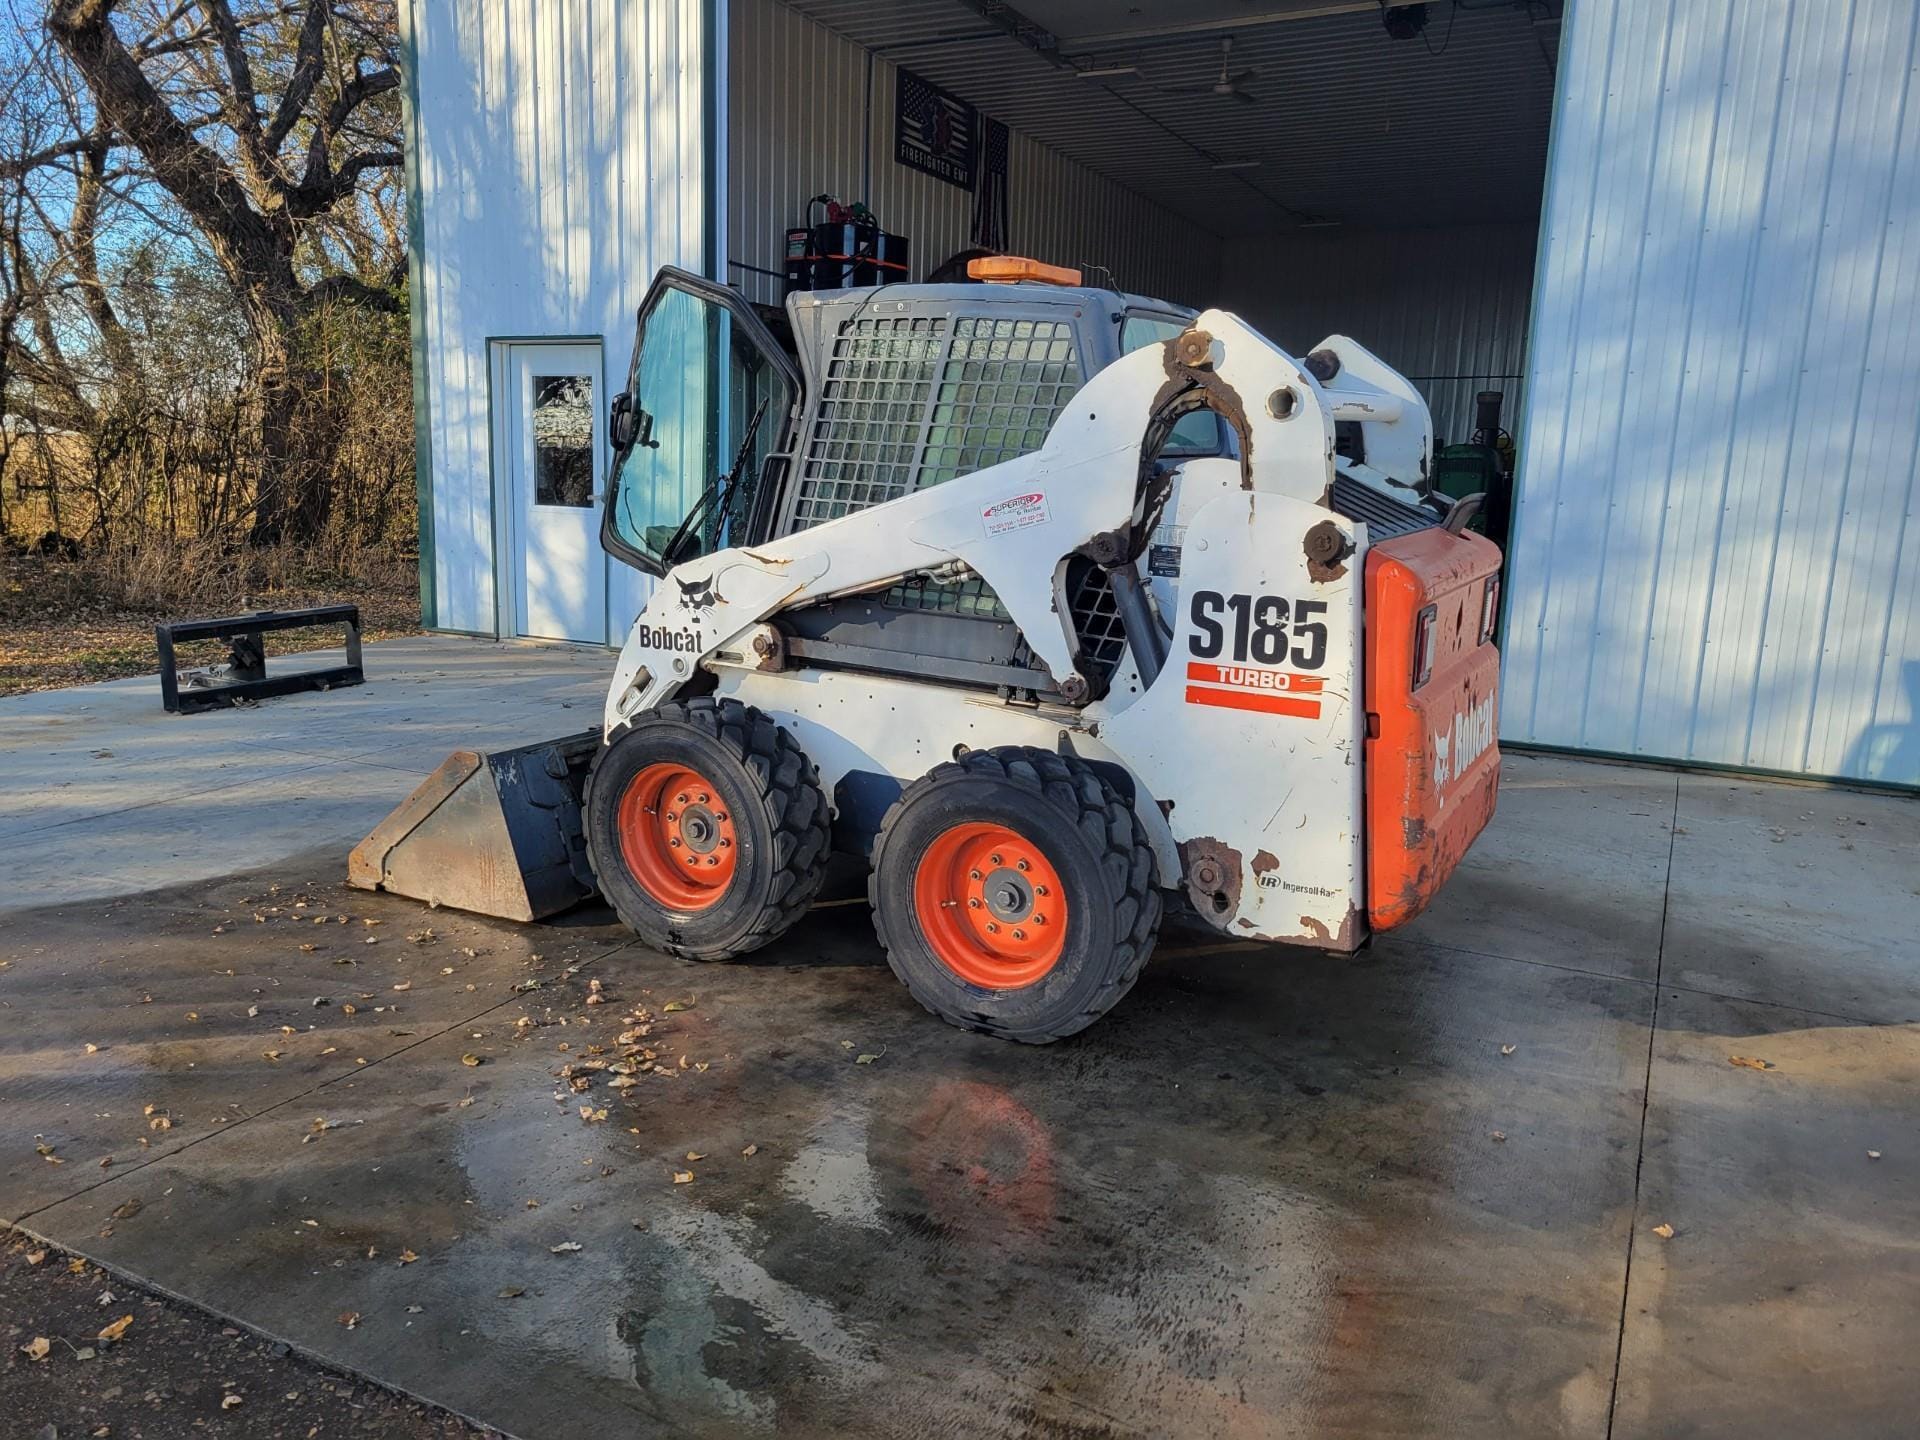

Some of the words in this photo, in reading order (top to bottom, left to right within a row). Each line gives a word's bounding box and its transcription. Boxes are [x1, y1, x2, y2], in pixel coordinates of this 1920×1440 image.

[901, 143, 951, 176] FIREFIGHTER
[953, 166, 968, 184] EMT
[990, 496, 1032, 513] SUPERIOR
[639, 624, 703, 654] Bobcat
[1188, 590, 1328, 670] S185
[1216, 666, 1290, 690] TURBO
[1260, 876, 1277, 888] IR
